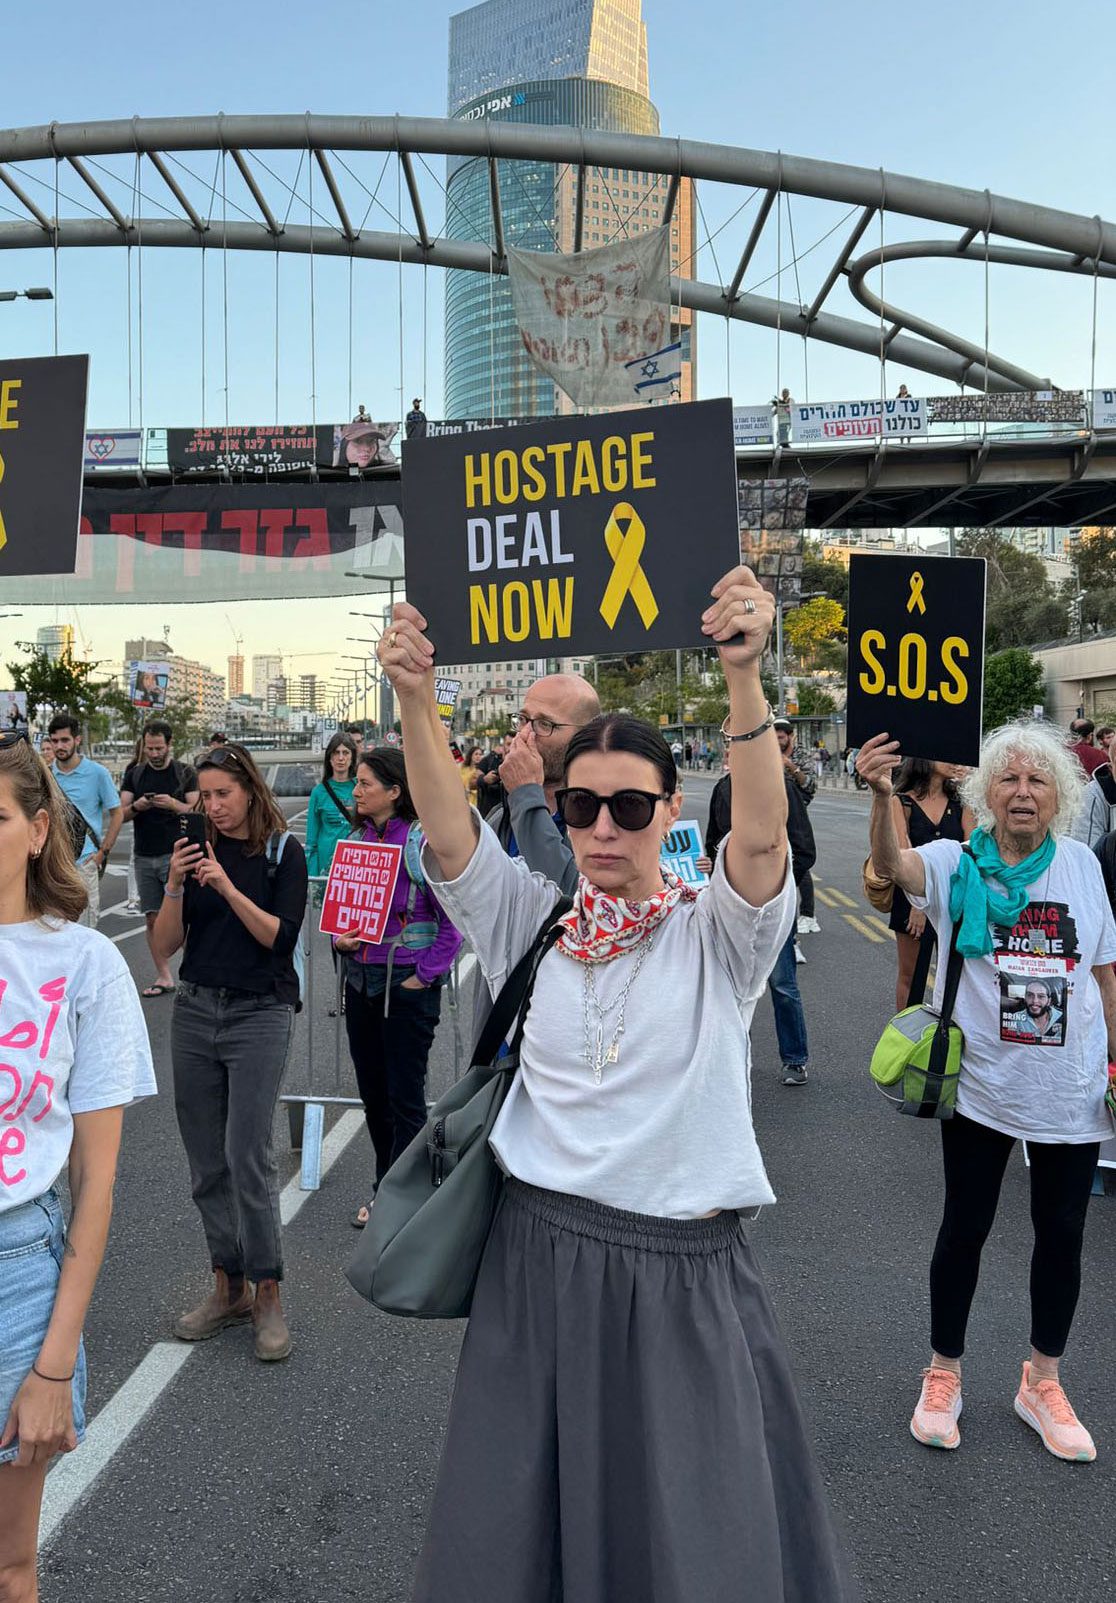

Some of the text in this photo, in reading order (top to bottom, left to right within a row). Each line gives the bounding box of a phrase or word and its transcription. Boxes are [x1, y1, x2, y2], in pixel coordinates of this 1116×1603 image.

[486, 95, 512, 113] אפי
[900, 400, 920, 412] עד
[886, 415, 921, 431] כולנו
[253, 451, 282, 463] לירי
[464, 432, 657, 508] HOSTAGE
[221, 508, 331, 573] גזר
[466, 509, 575, 572] DEAL
[468, 576, 575, 645] NOW
[859, 629, 970, 705] S.O.S
[435, 679, 460, 692] EAVING
[332, 863, 380, 884] החטופים
[328, 879, 386, 909] בוחרות
[336, 905, 381, 936] בחיים
[1002, 1011, 1026, 1021] BRING
